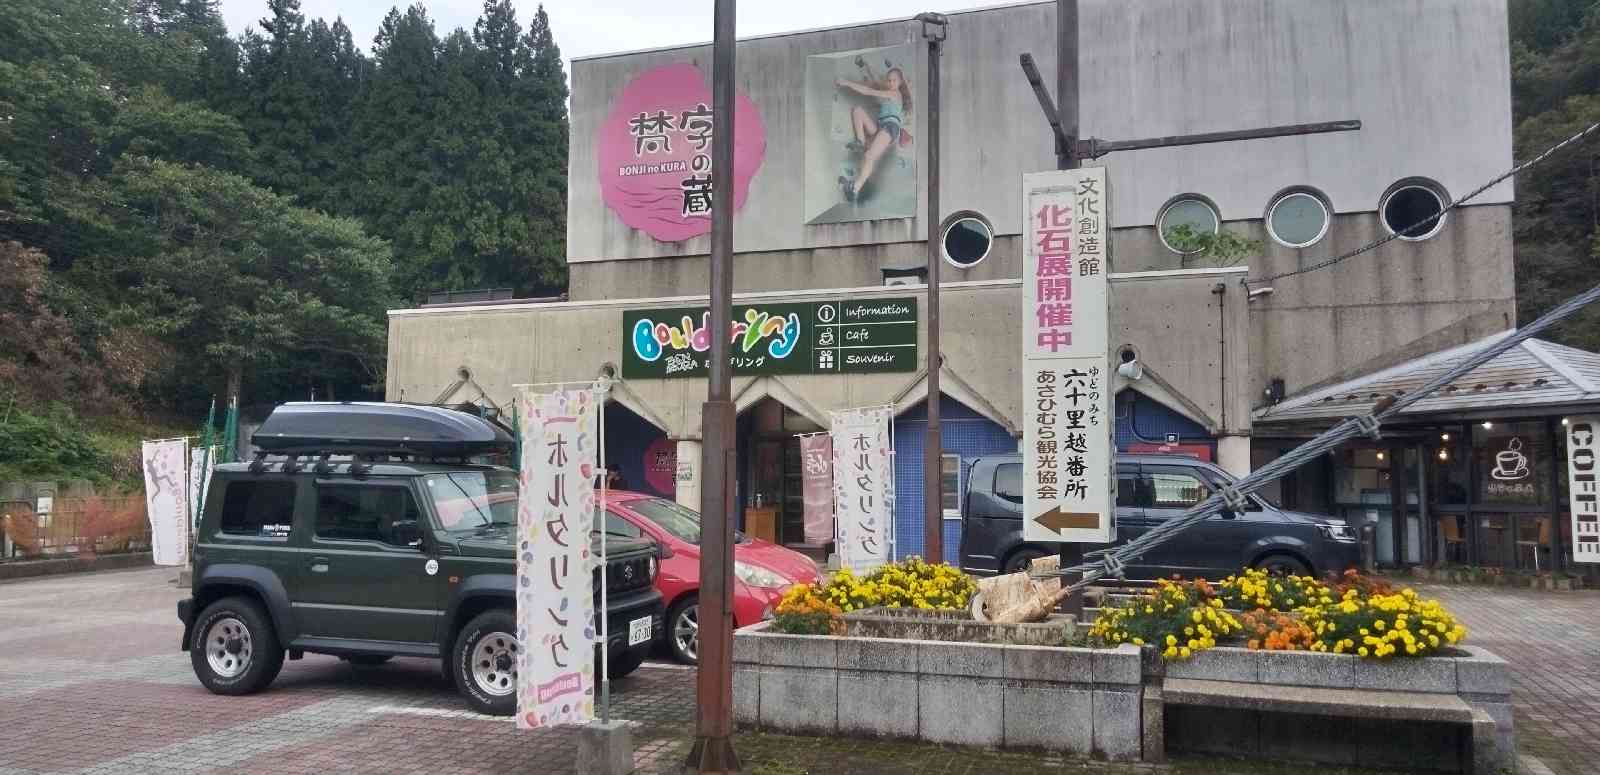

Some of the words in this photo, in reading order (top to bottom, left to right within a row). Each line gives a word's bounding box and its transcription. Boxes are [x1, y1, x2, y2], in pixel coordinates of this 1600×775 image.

[619, 164, 647, 176] BONJI
[648, 165, 660, 174] no
[660, 161, 687, 173] KURA
[1078, 177, 1100, 277] 文化創造館
[846, 305, 909, 319] Information
[1037, 204, 1072, 352] 化石展開催中
[632, 308, 800, 361] Bouldring
[846, 353, 895, 364] Souvenir
[1036, 370, 1059, 500] あさひむら観光協会
[1063, 368, 1088, 501] 六十里越番所
[1089, 366, 1100, 426] ゆどのみち
[1572, 423, 1600, 553] COFFEE
